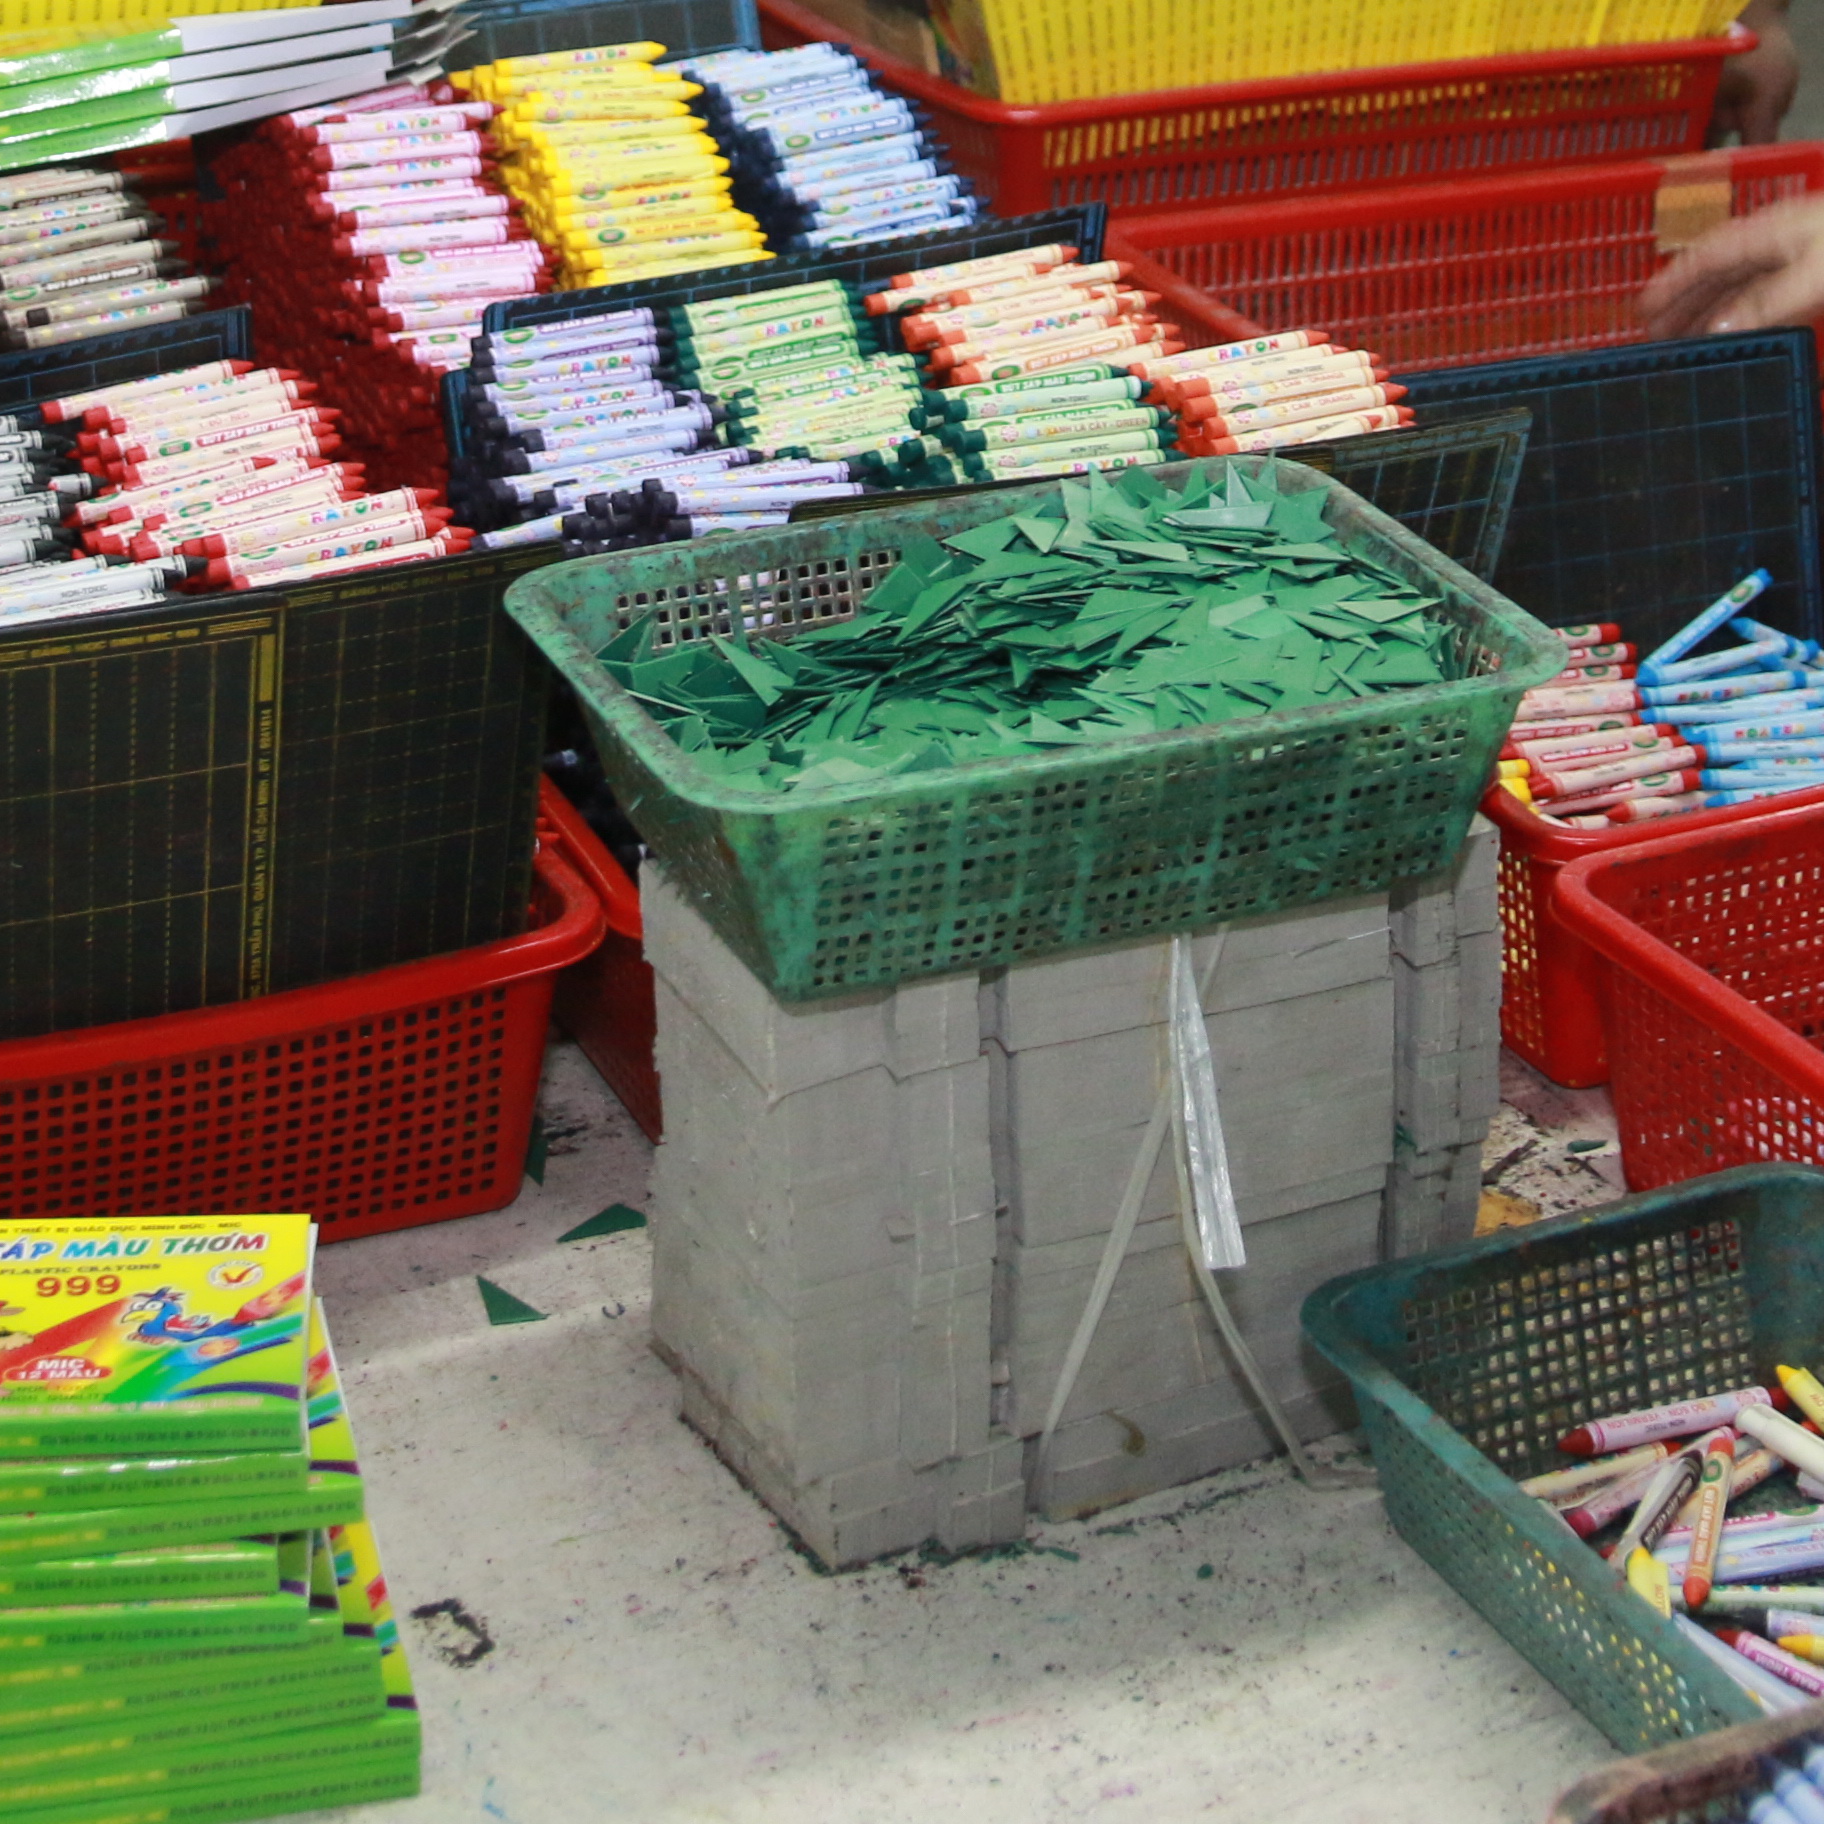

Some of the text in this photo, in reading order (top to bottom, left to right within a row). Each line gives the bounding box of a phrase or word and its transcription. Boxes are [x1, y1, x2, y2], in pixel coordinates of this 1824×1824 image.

[755, 316, 824, 337] CRAYON
[1208, 339, 1279, 362] CRAYON
[558, 355, 632, 375] CRAYON
[297, 501, 383, 525] CRAYON
[307, 537, 393, 562] CRAYON
[61, 584, 108, 598] NON-TOXIC
[63, 1234, 150, 1259] MÀU
[164, 1231, 267, 1256] THƠM
[0, 1263, 162, 1275] PLASTIC CRAYONS
[36, 1274, 122, 1297] 999
[37, 1358, 85, 1369] MIC
[18, 1370, 43, 1380] 12
[1606, 1411, 1660, 1430] VERMILION
